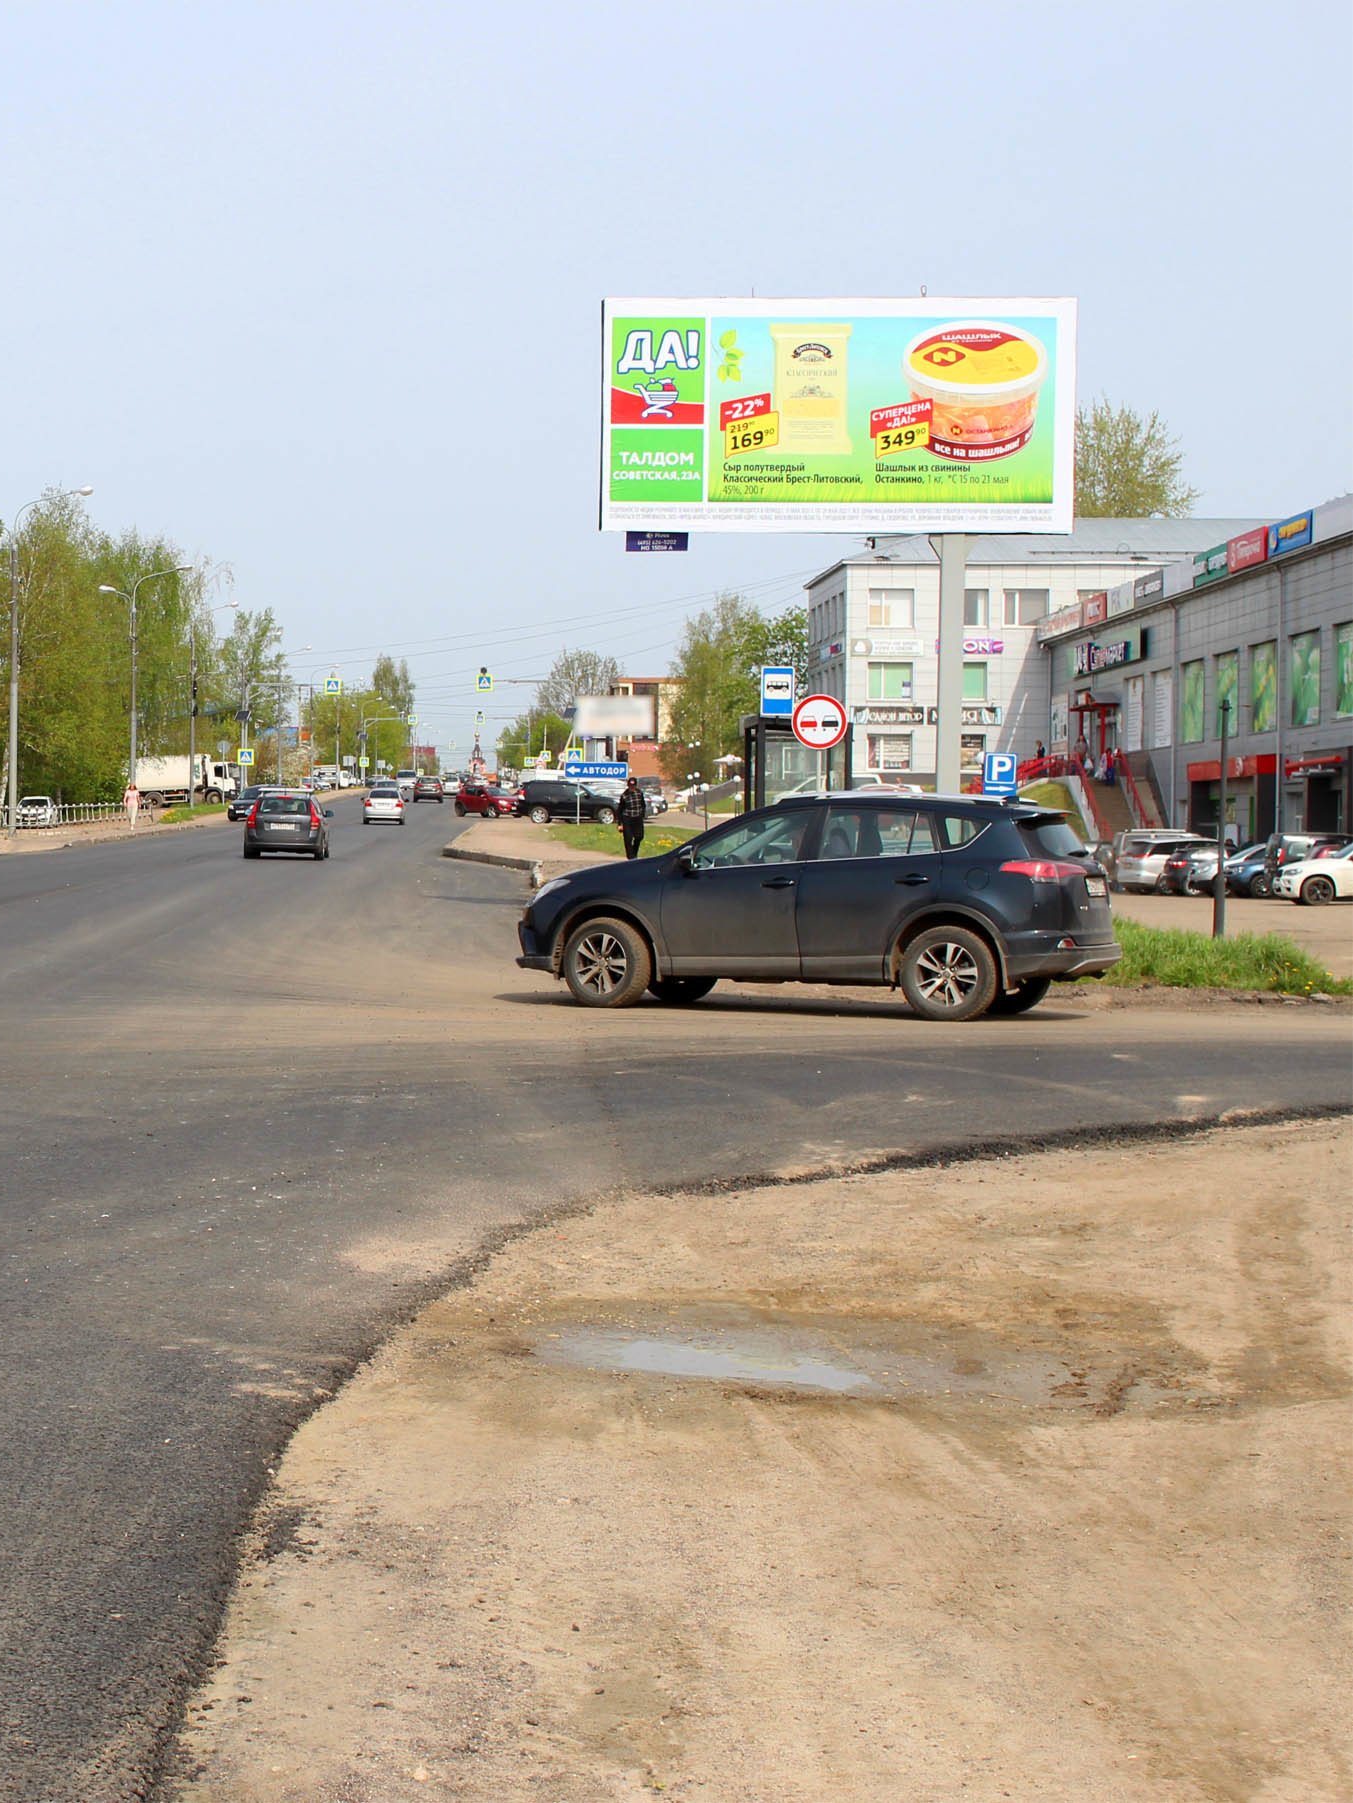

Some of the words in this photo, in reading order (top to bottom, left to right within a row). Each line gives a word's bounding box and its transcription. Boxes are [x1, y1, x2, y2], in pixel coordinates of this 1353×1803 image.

[617, 329, 701, 374] ДА!
[725, 398, 764, 419] -22%
[872, 402, 932, 421] СУПЕРЦЕНА
[731, 430, 764, 451] 169
[880, 430, 915, 450] 349
[619, 452, 694, 467] ТАЛДОМ
[723, 462, 742, 473] Сыр
[744, 462, 805, 473] полутвердый
[875, 463, 917, 473] Шашлык
[918, 465, 929, 473] из
[931, 465, 971, 473] свинины
[723, 474, 784, 484] Классический
[786, 474, 864, 485] Брест-Литовский,
[875, 474, 925, 485] Останкино,
[960, 475, 968, 484] 15
[970, 476, 980, 484] по
[723, 485, 742, 496] 45%,
[744, 485, 759, 495] 200
[583, 766, 626, 775] АВТОДОР
